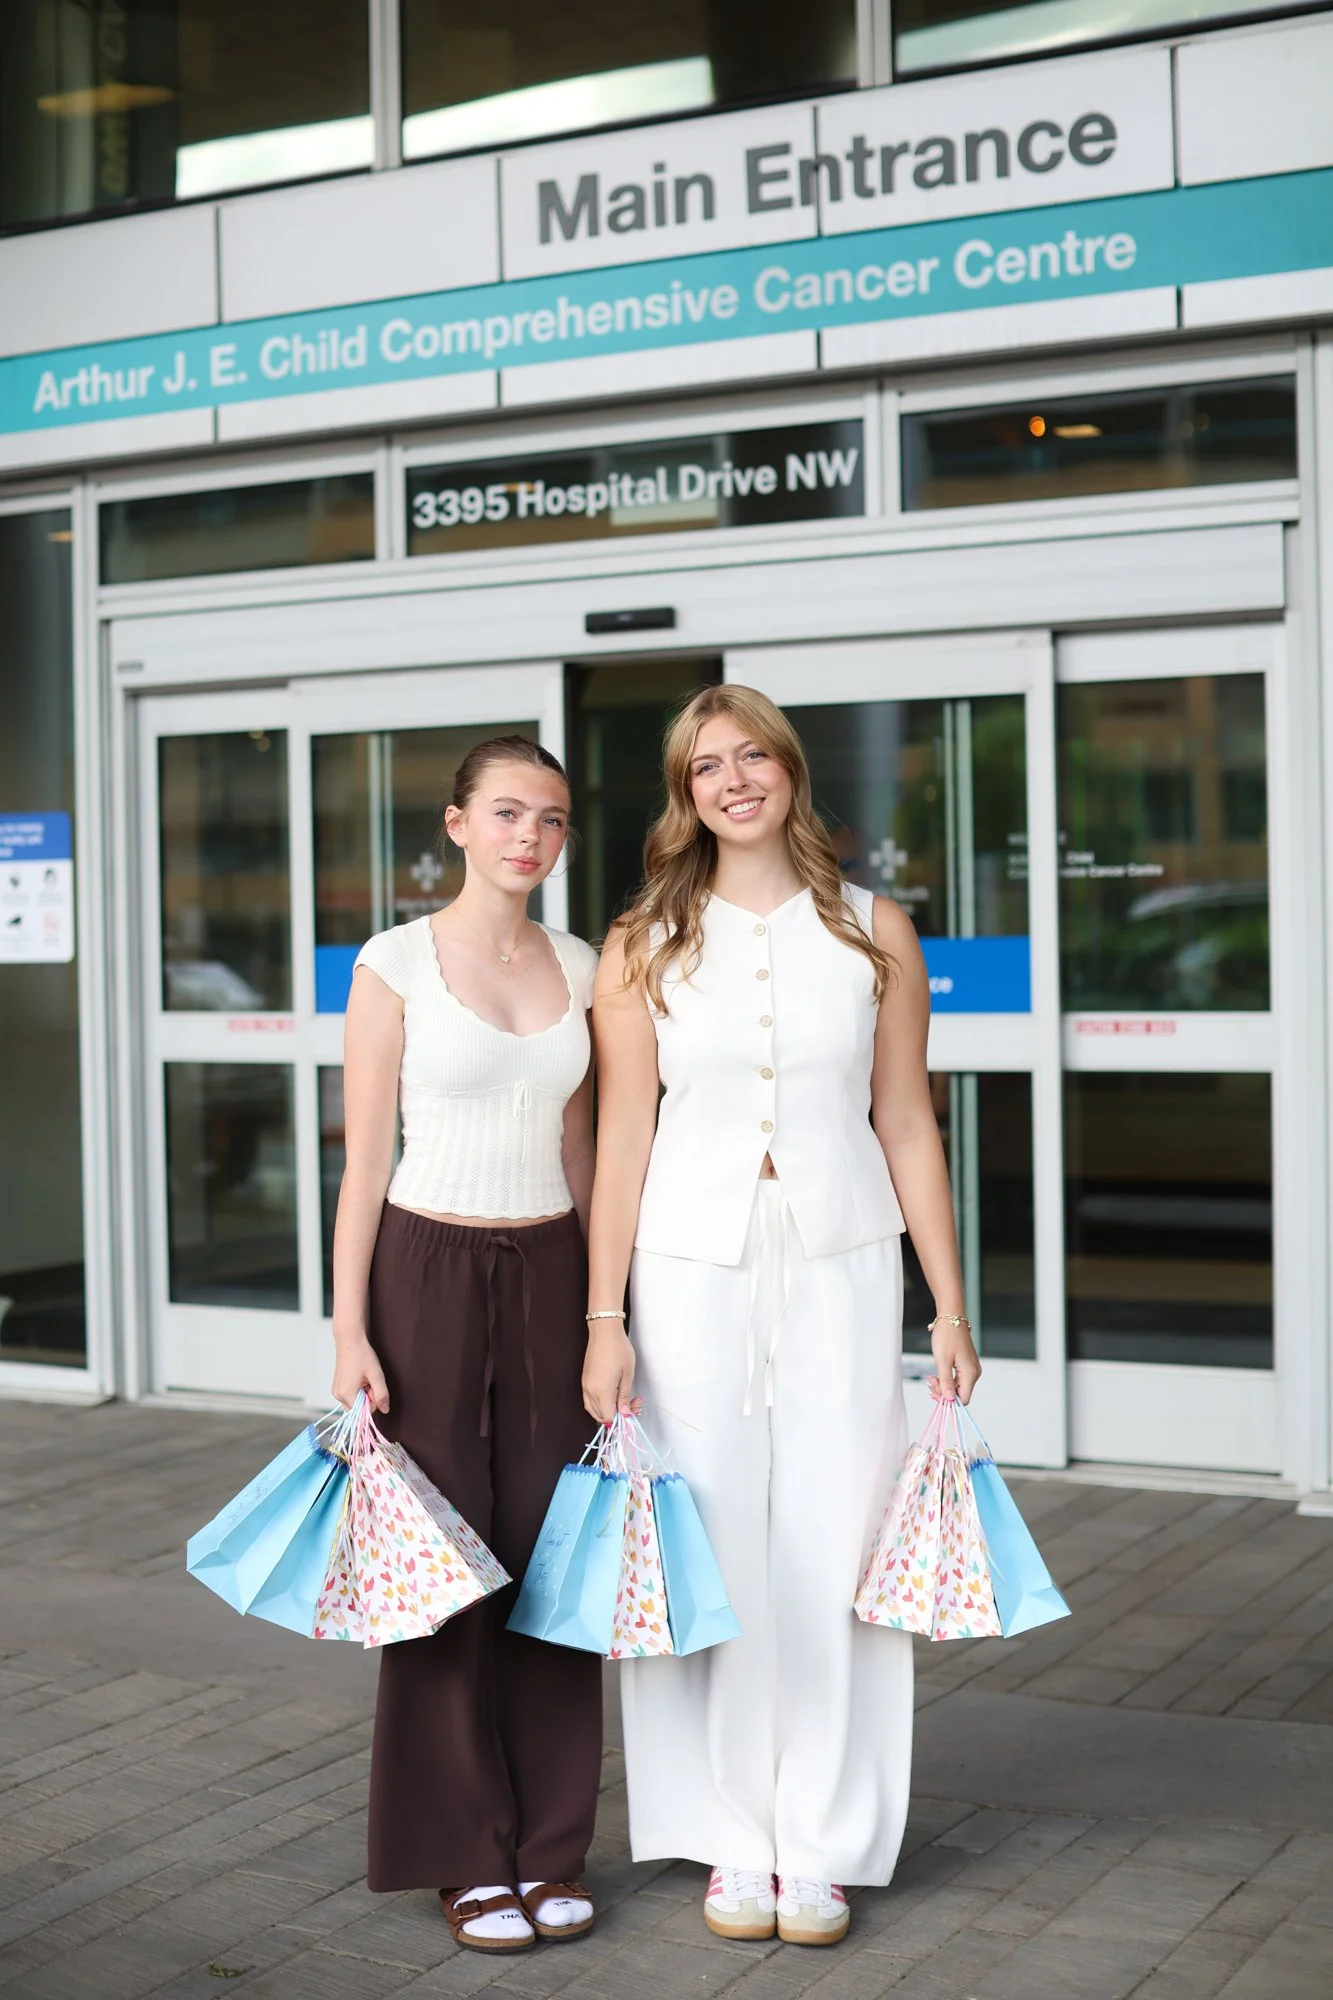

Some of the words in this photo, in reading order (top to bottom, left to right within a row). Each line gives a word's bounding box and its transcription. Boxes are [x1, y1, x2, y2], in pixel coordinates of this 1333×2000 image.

[538, 162, 715, 243] Main
[745, 111, 1118, 214] Entrance
[33, 365, 155, 412] Arthur
[163, 351, 196, 392] J.
[210, 344, 247, 387] E.
[260, 327, 367, 378] Child
[380, 280, 740, 359] Comprehensive
[754, 257, 939, 314] Cancer
[954, 230, 1137, 288] Centre
[413, 484, 510, 528] 3395
[516, 465, 668, 518] Hospital
[678, 461, 777, 501] Drive
[786, 449, 858, 491] NW
